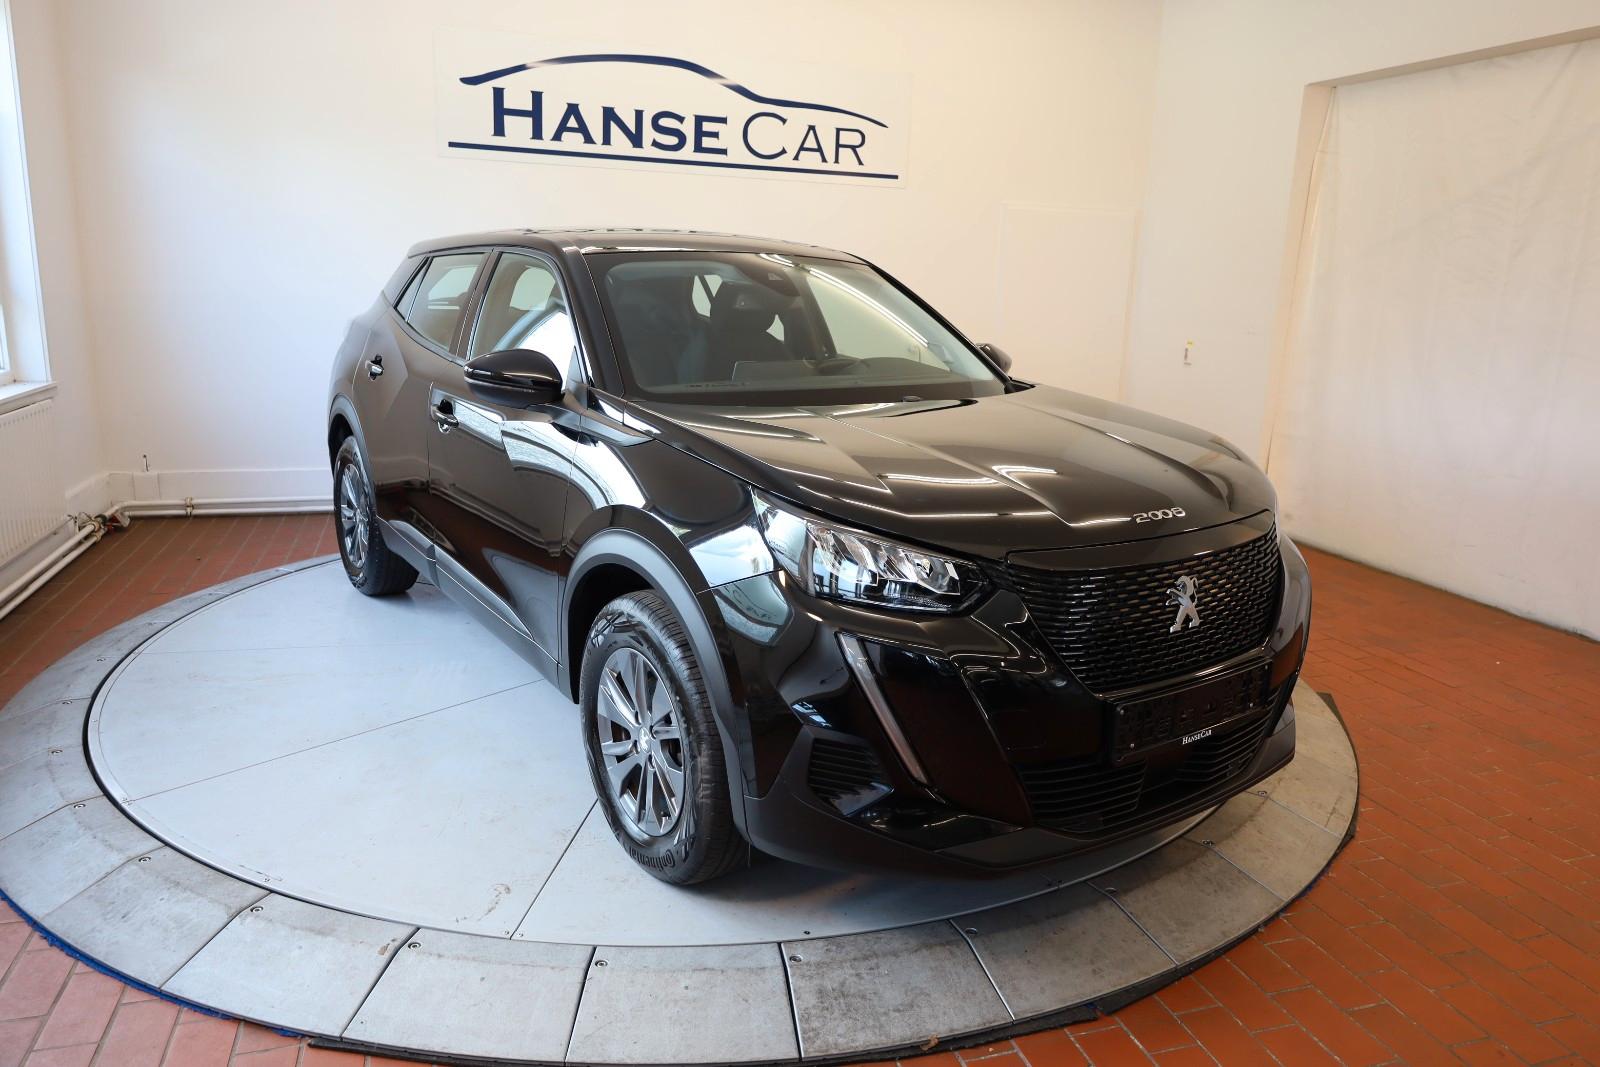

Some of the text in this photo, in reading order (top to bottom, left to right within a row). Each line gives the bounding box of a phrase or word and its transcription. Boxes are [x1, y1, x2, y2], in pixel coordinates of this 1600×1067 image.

[492, 87, 867, 166] HANSE CAR
[1133, 507, 1186, 524] 2008
